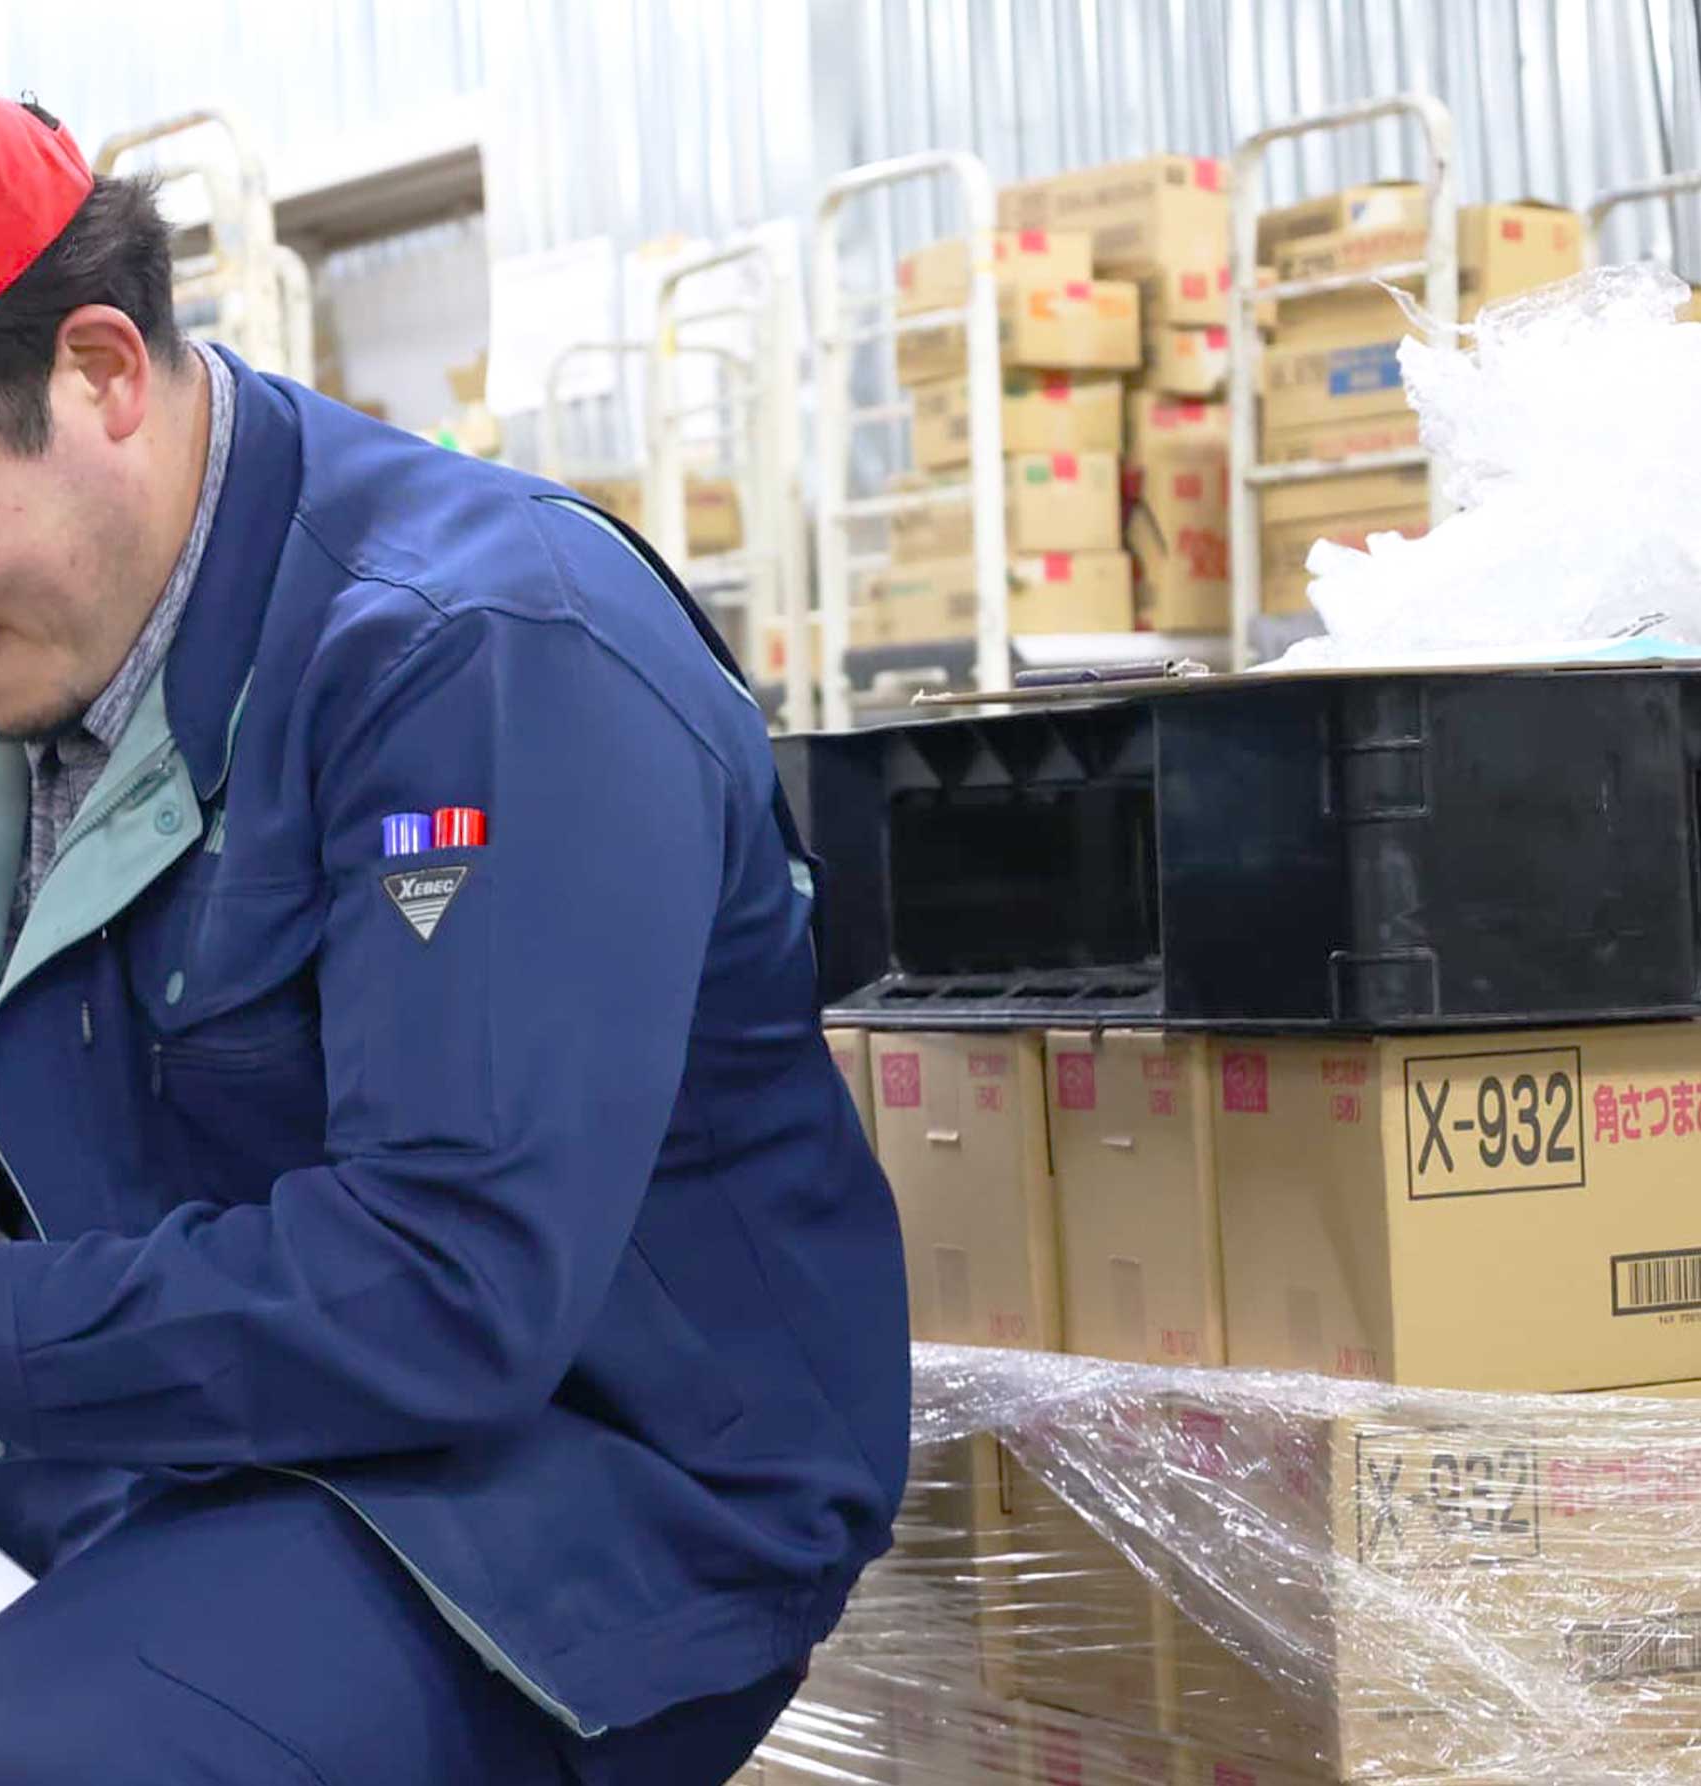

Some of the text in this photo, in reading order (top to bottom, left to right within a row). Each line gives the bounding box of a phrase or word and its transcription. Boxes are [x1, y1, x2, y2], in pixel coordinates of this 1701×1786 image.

[1416, 1071, 1576, 1175] X-932
[1594, 1081, 1701, 1144] 角さつま
